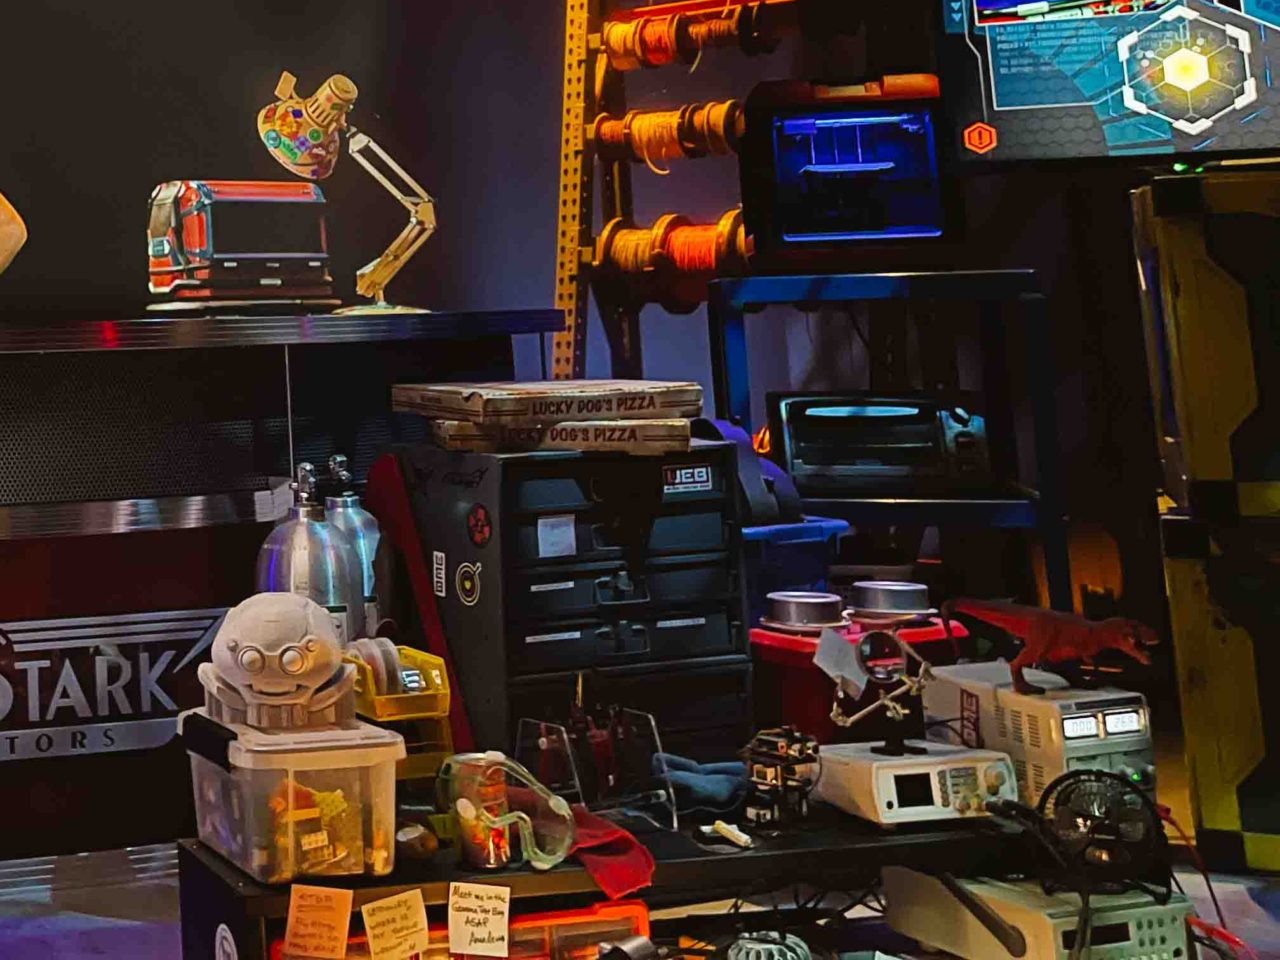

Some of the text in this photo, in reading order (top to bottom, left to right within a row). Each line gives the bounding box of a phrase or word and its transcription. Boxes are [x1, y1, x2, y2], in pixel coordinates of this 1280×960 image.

[532, 395, 656, 416] LUCKY DOG'S PIZZA
[550, 427, 590, 442] DOG'S
[594, 427, 638, 442] PIZZA
[464, 916, 489, 928] ASAP
